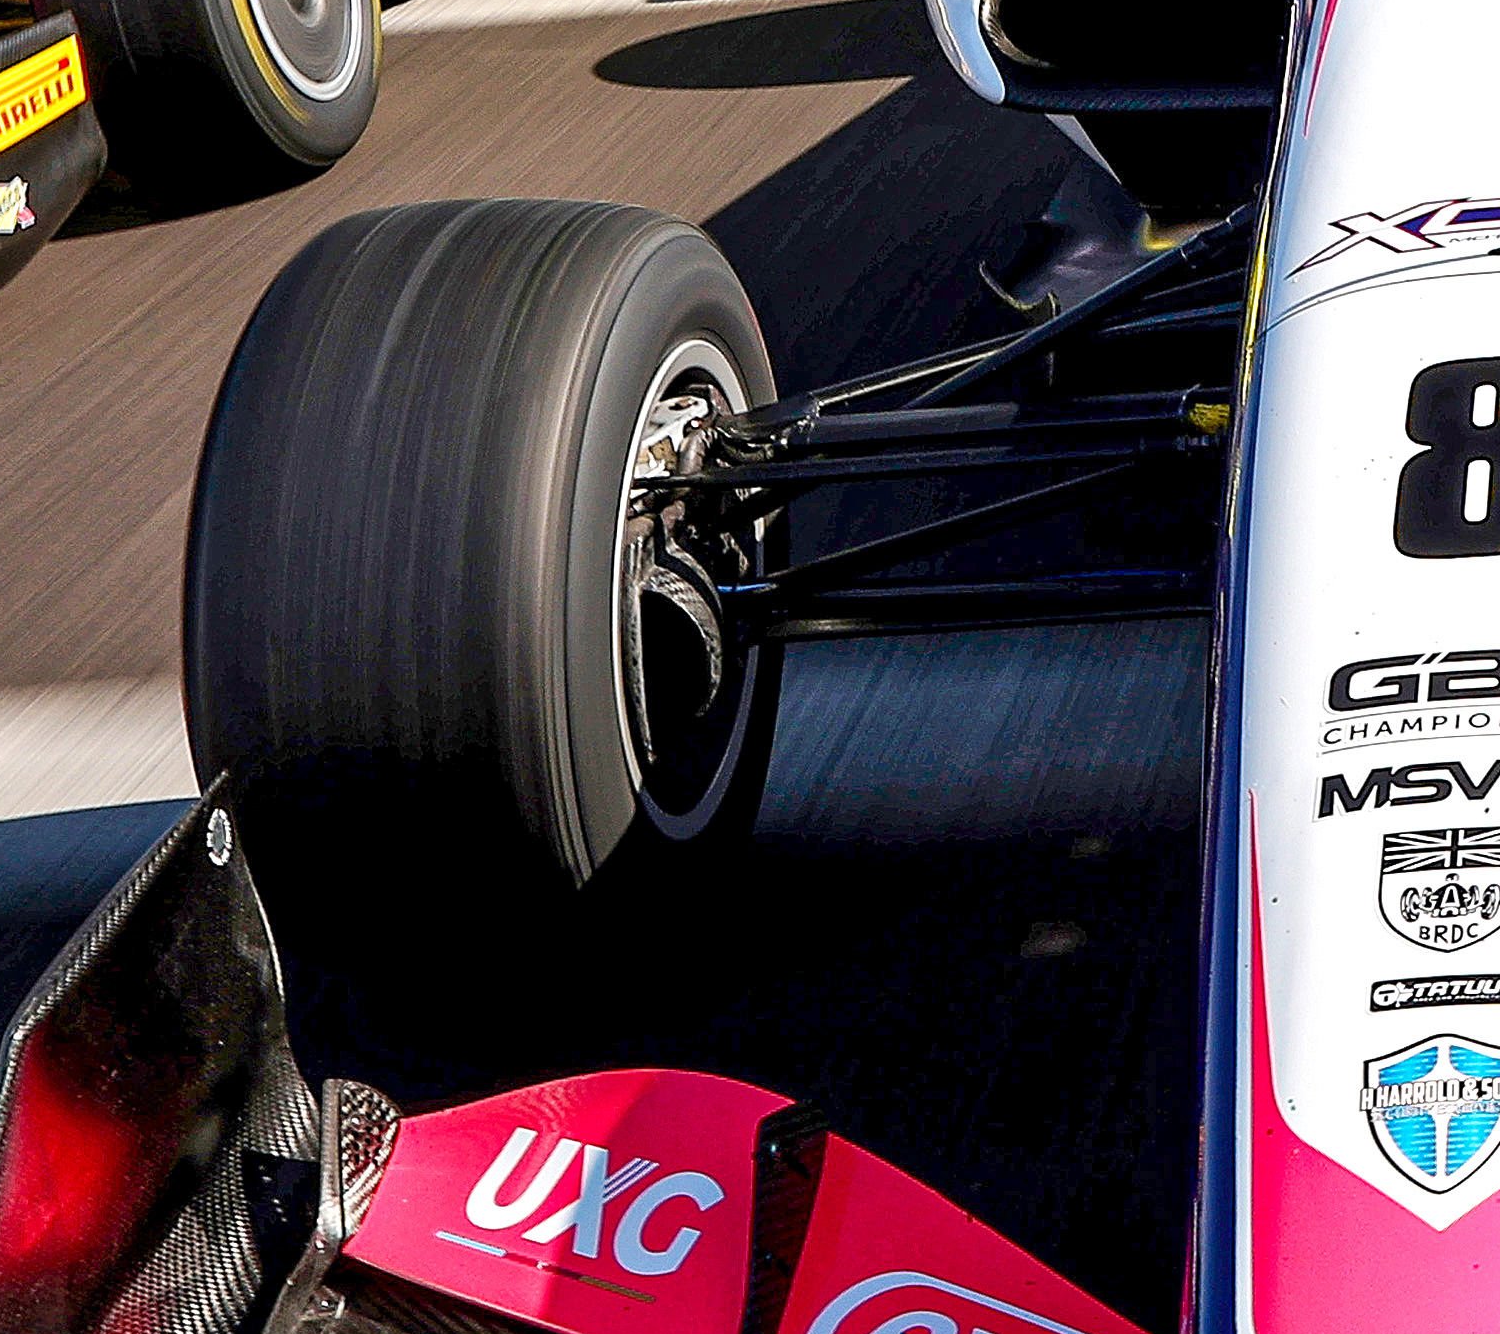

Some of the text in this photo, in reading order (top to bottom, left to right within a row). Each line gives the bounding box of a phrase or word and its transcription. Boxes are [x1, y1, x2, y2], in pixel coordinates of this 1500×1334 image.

[1418, 922, 1479, 945] BRDC
[1360, 1087, 1375, 1112] H
[1376, 1078, 1460, 1109] HARROLD
[1461, 1077, 1479, 1102] &
[465, 1126, 726, 1276] UXG
